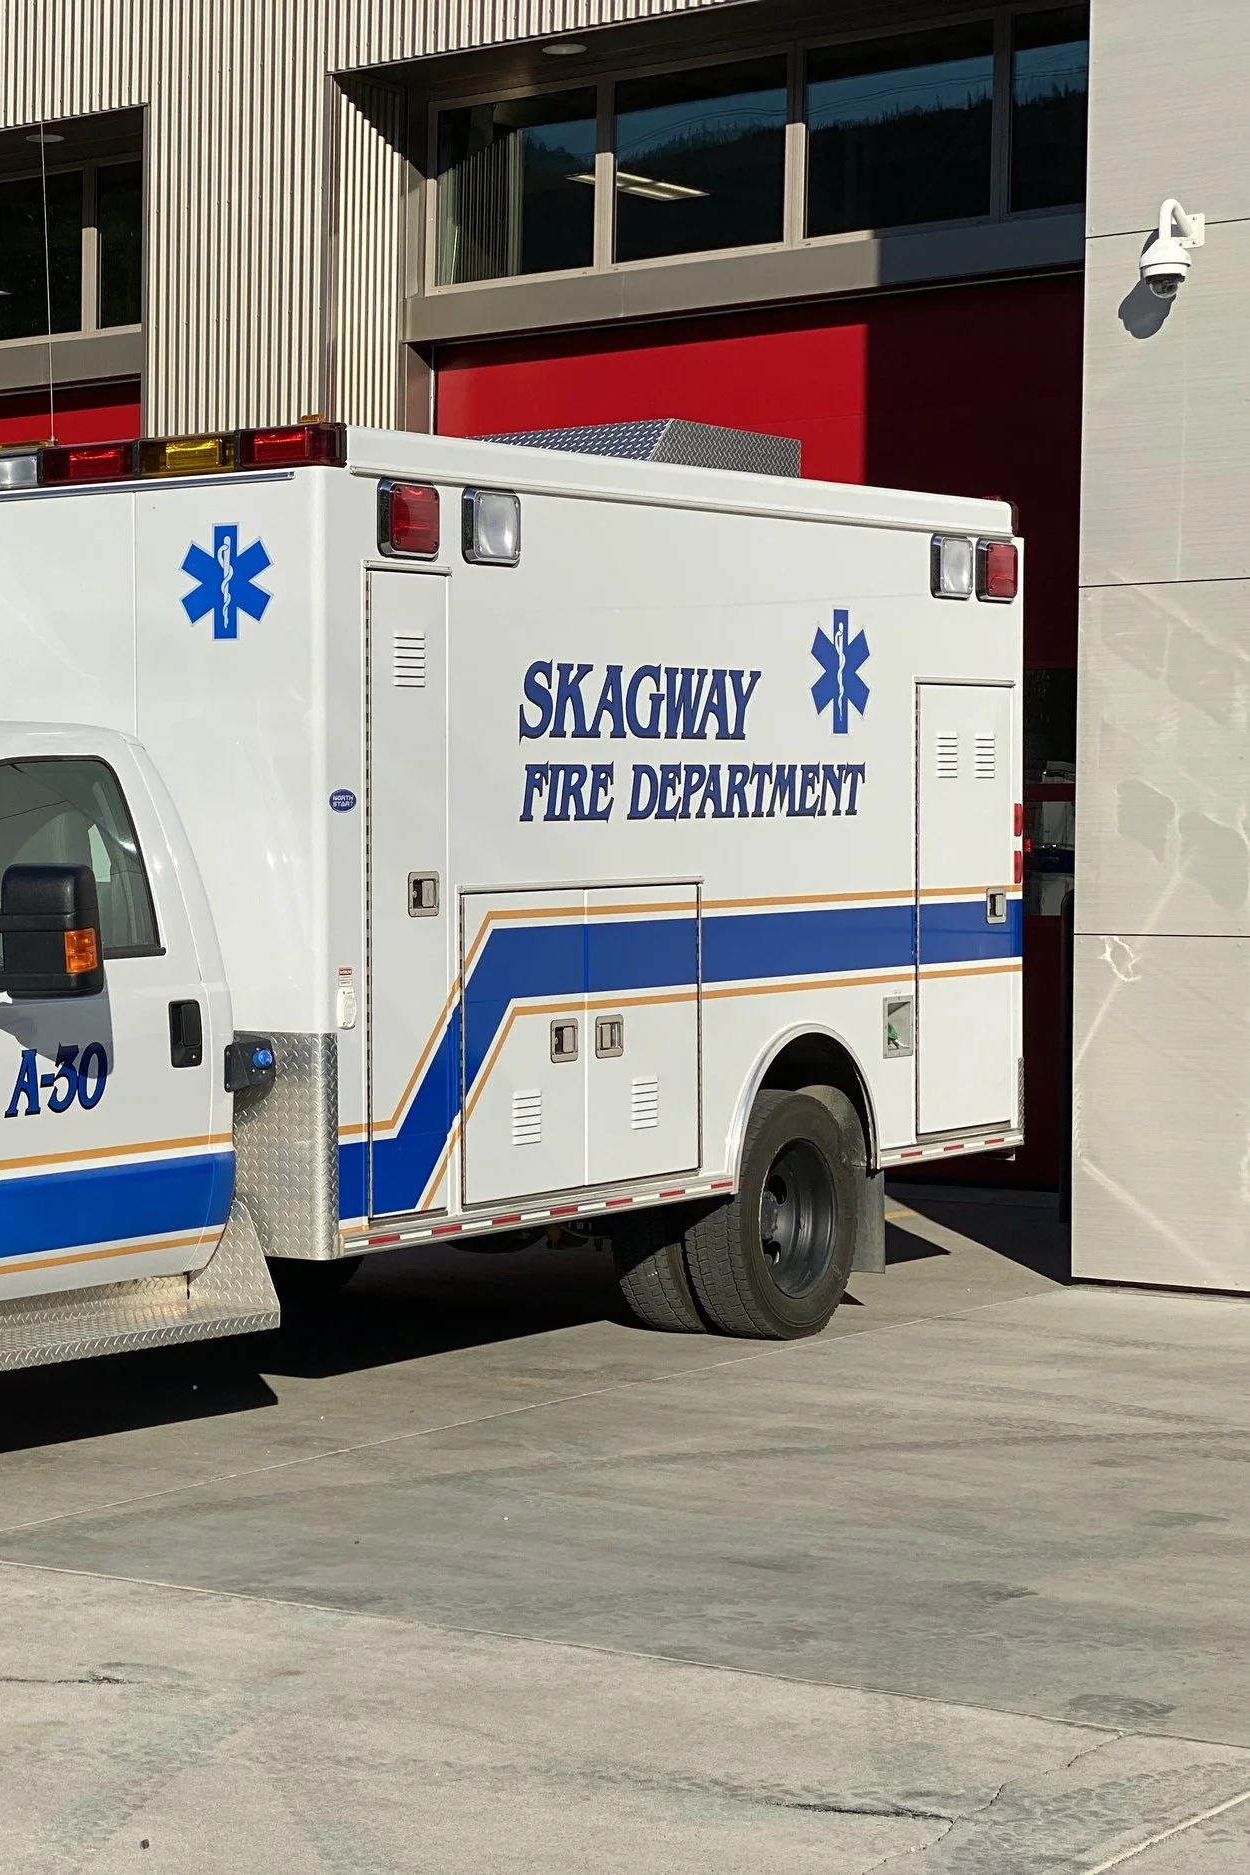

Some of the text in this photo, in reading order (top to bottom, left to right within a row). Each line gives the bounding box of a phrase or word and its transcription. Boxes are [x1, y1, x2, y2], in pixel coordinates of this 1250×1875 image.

[519, 659, 762, 746] SKAGWAY
[519, 760, 866, 823] FIRE DEPARTMENT
[4, 1042, 108, 1118] A-30
